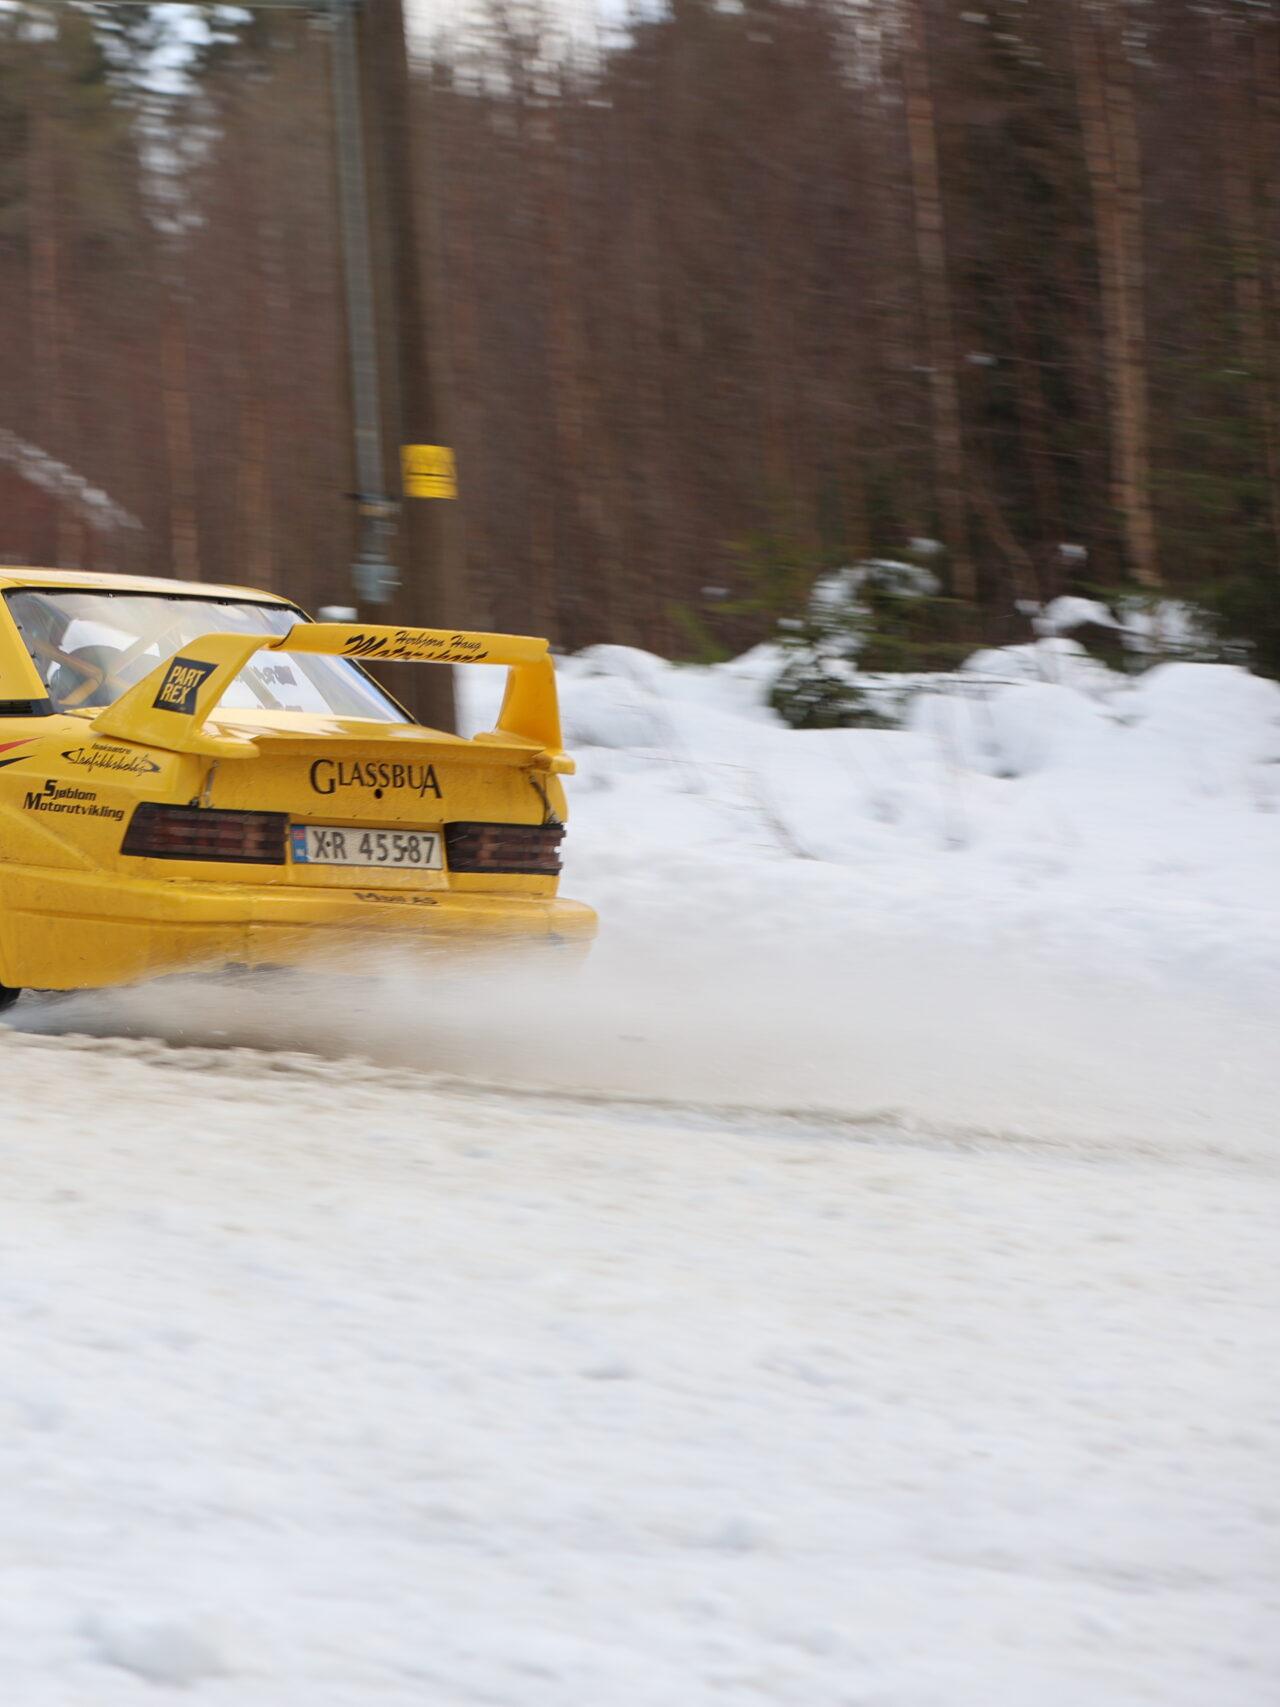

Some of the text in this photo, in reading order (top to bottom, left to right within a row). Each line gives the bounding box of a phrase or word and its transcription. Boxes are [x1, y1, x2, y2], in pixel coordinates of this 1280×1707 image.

[169, 665, 205, 687] PART
[160, 684, 191, 704] REX
[43, 779, 97, 800] Sjøblom
[310, 759, 442, 798] GLASSBUA
[23, 792, 125, 821] Motorutvikling
[359, 832, 435, 864] 45587
